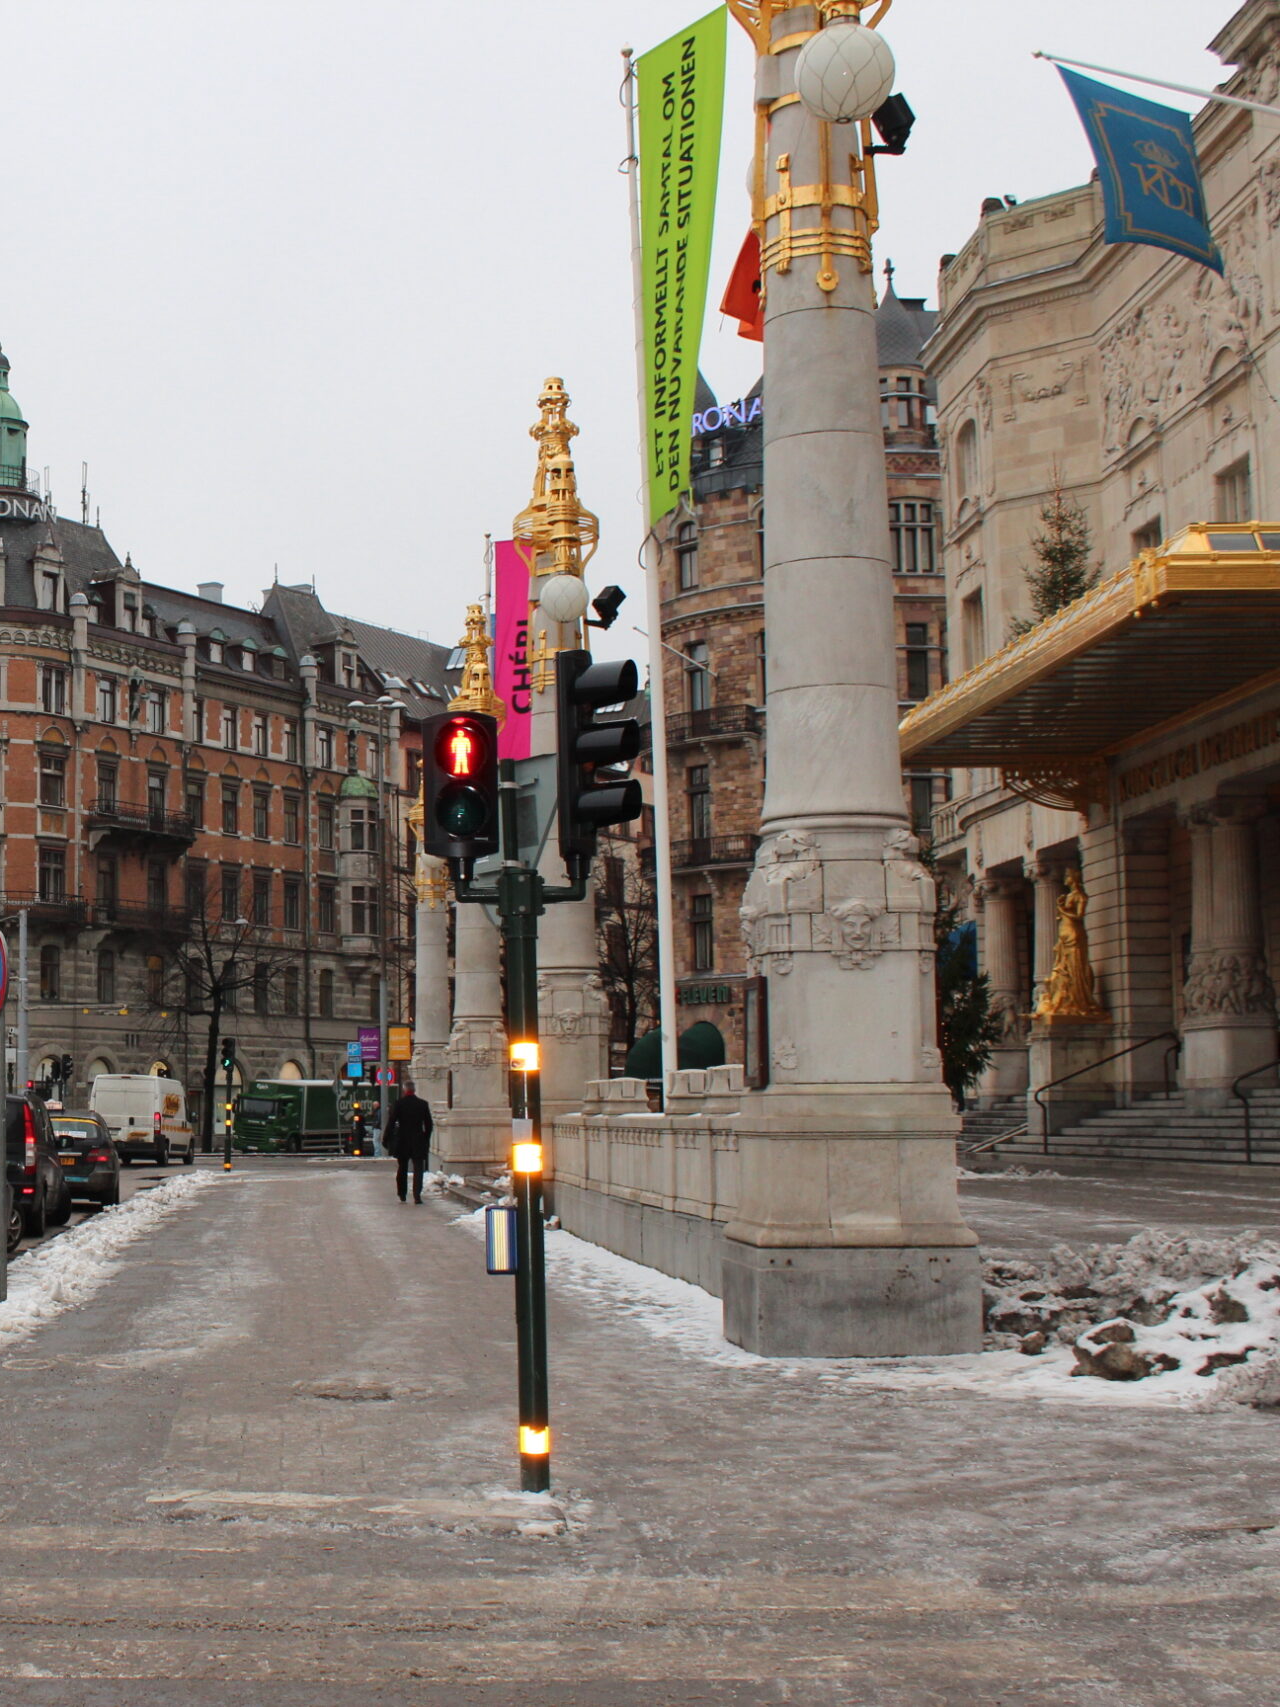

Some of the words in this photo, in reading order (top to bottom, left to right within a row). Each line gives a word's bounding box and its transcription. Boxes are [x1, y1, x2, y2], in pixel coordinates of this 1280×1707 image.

[662, 71, 676, 121] OM
[658, 125, 674, 238] SAMTAL
[654, 247, 669, 418] INFORMELLT
[668, 430, 681, 493] DEN
[677, 35, 696, 229] SITUATIONEN
